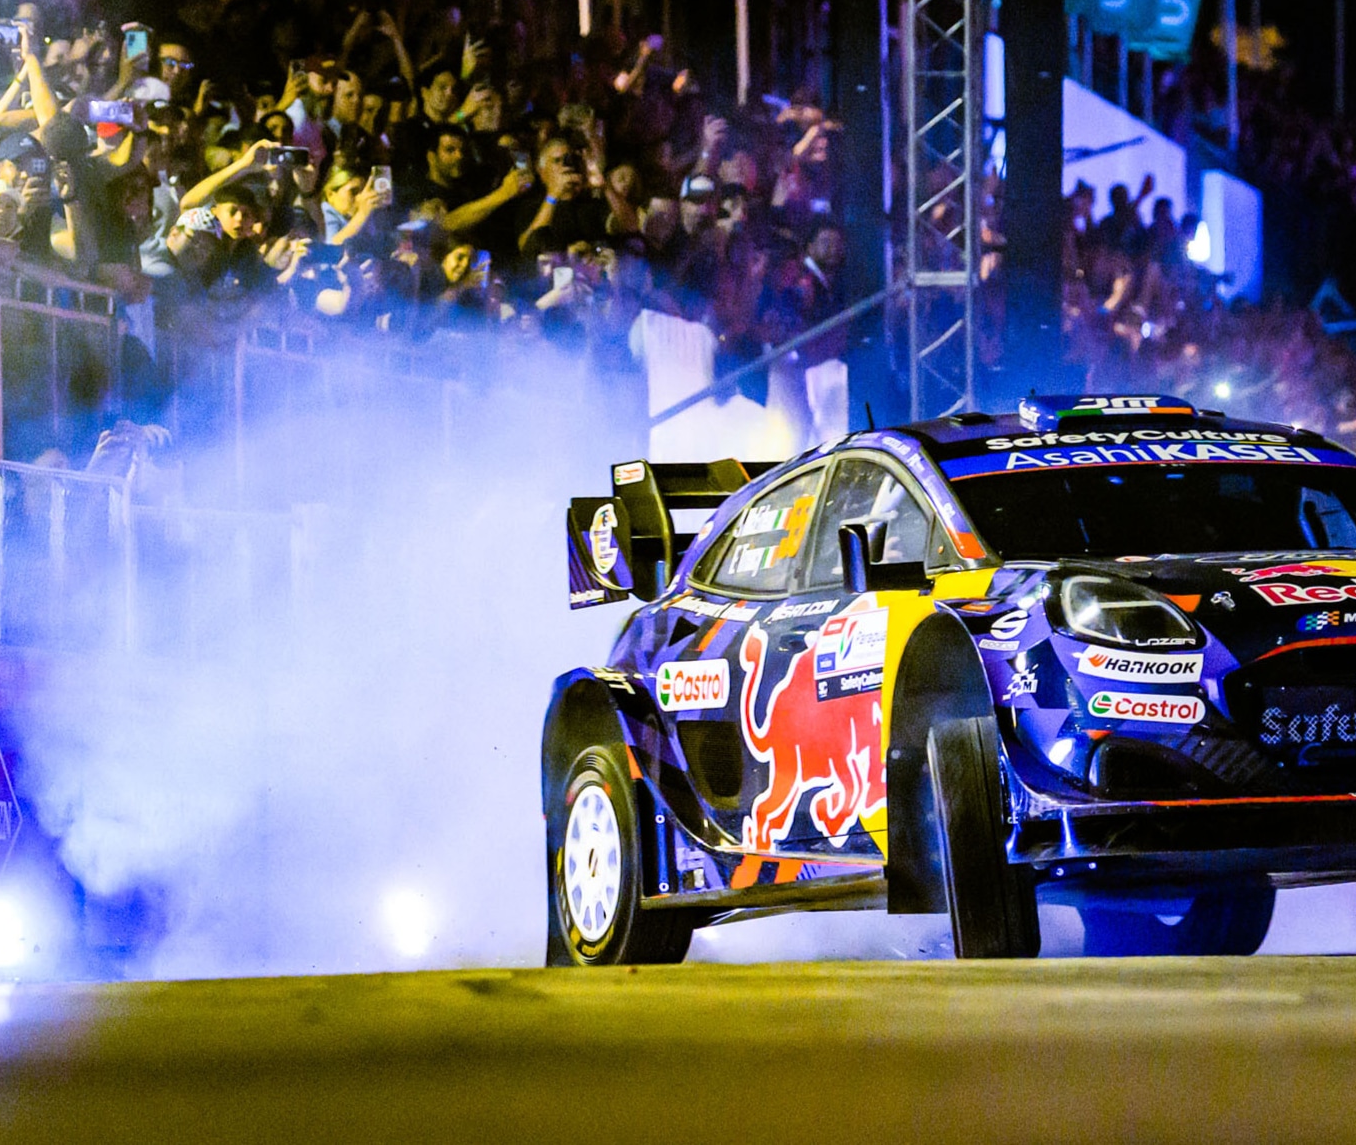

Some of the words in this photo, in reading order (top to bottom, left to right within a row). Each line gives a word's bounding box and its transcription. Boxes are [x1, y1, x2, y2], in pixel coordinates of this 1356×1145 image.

[985, 429, 1288, 450] SafetyCulture
[1005, 444, 1322, 470] AsahiKASEI
[672, 668, 726, 703] Castrol
[1114, 697, 1199, 720] Castrol
